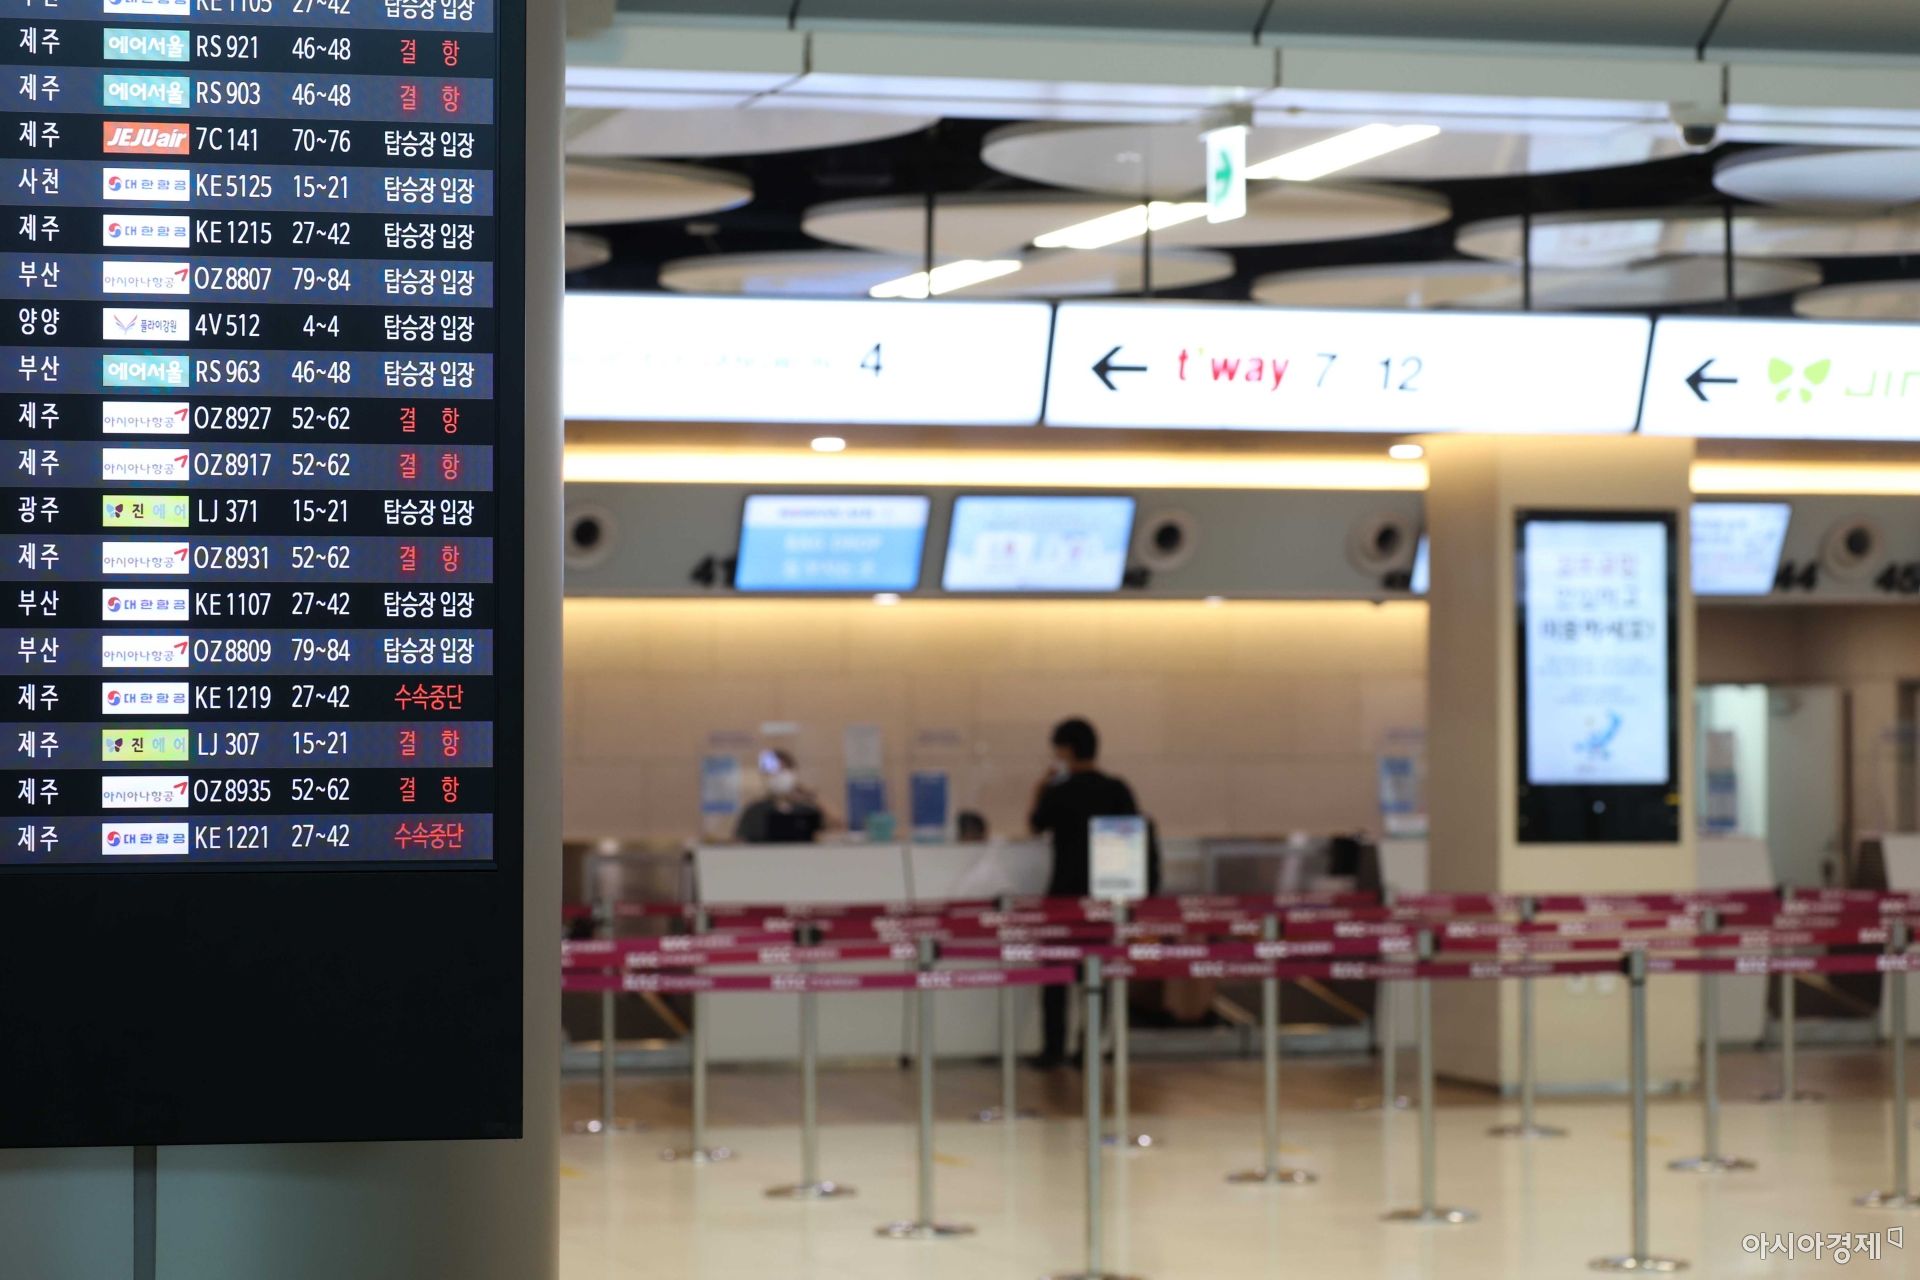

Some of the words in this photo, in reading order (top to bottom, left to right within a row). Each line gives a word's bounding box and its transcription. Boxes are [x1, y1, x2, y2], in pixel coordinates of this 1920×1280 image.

[19, 26, 60, 55] 제주
[108, 35, 184, 58] 에어서울
[292, 36, 351, 61] 46~48
[19, 73, 61, 102] 제주
[108, 81, 184, 105] 에어서울
[291, 82, 351, 107] 46~48
[19, 120, 60, 148] 제주
[107, 127, 188, 148] JEJUair
[292, 128, 351, 153] 70~76
[384, 130, 437, 158] 탑승장
[440, 131, 475, 159] 입장
[18, 167, 59, 195] 사천
[125, 178, 187, 190] 대한항공
[293, 174, 348, 199] 15~21
[384, 175, 437, 204] 탑승장
[440, 177, 475, 205] 입장
[18, 213, 60, 242] 제주
[125, 225, 187, 238] 대한항공
[292, 221, 351, 245] 27~42
[384, 222, 437, 250] 탑승장
[440, 223, 475, 251] 입장
[18, 261, 60, 288] 부산
[104, 276, 175, 289] 아시아나항공
[291, 267, 352, 292] 79~84
[384, 267, 437, 296] 탑승장
[440, 269, 475, 296] 입장
[18, 307, 60, 336] 양양
[140, 319, 178, 333] 플라이강원
[302, 314, 340, 338] 4~4
[384, 314, 437, 342] 탑승장
[440, 315, 475, 342] 입장
[18, 355, 60, 382] 부산
[107, 360, 183, 383] 에어서울
[291, 360, 351, 384] 46~48
[384, 360, 437, 388] 탑승장
[440, 361, 475, 388] 입장
[1315, 352, 1338, 388] 7
[1379, 354, 1424, 392] 12
[18, 401, 60, 429] 제주
[104, 416, 175, 429] 아시아나항공
[292, 406, 350, 430] 52~62
[18, 448, 60, 476] 제주
[103, 463, 175, 475] 아시아나항공
[291, 452, 350, 476] 52~62
[18, 496, 60, 523] 광주
[293, 499, 347, 522] 15~21
[384, 498, 437, 526] 탑승장
[440, 499, 475, 526] 입장
[18, 542, 60, 570] 제주
[103, 557, 175, 569] 아시아나항공
[291, 545, 350, 569] 52~62
[17, 590, 60, 616] 부산
[124, 599, 186, 611] 대한항공
[291, 591, 350, 615] 27~42
[384, 591, 437, 618] 탑승장
[440, 591, 475, 618] 입장
[17, 637, 60, 664] 부산
[103, 650, 175, 663] 아시아나항공
[291, 638, 351, 662] 79~84
[383, 637, 437, 664] 탑승장
[440, 637, 475, 664] 입장
[18, 683, 59, 711] 제주
[124, 692, 186, 704] 대한항공
[291, 684, 350, 708] 27~42
[394, 683, 463, 710] 수속중단
[17, 730, 59, 758] 제주
[292, 731, 347, 755] 15~21
[17, 777, 59, 805] 제주
[103, 791, 175, 803] 아시아나항공
[291, 777, 350, 801] 52~62
[17, 824, 59, 852] 제주
[123, 833, 186, 845] 대한항공
[291, 823, 350, 848] 27~42
[394, 822, 464, 849] 수속중단
